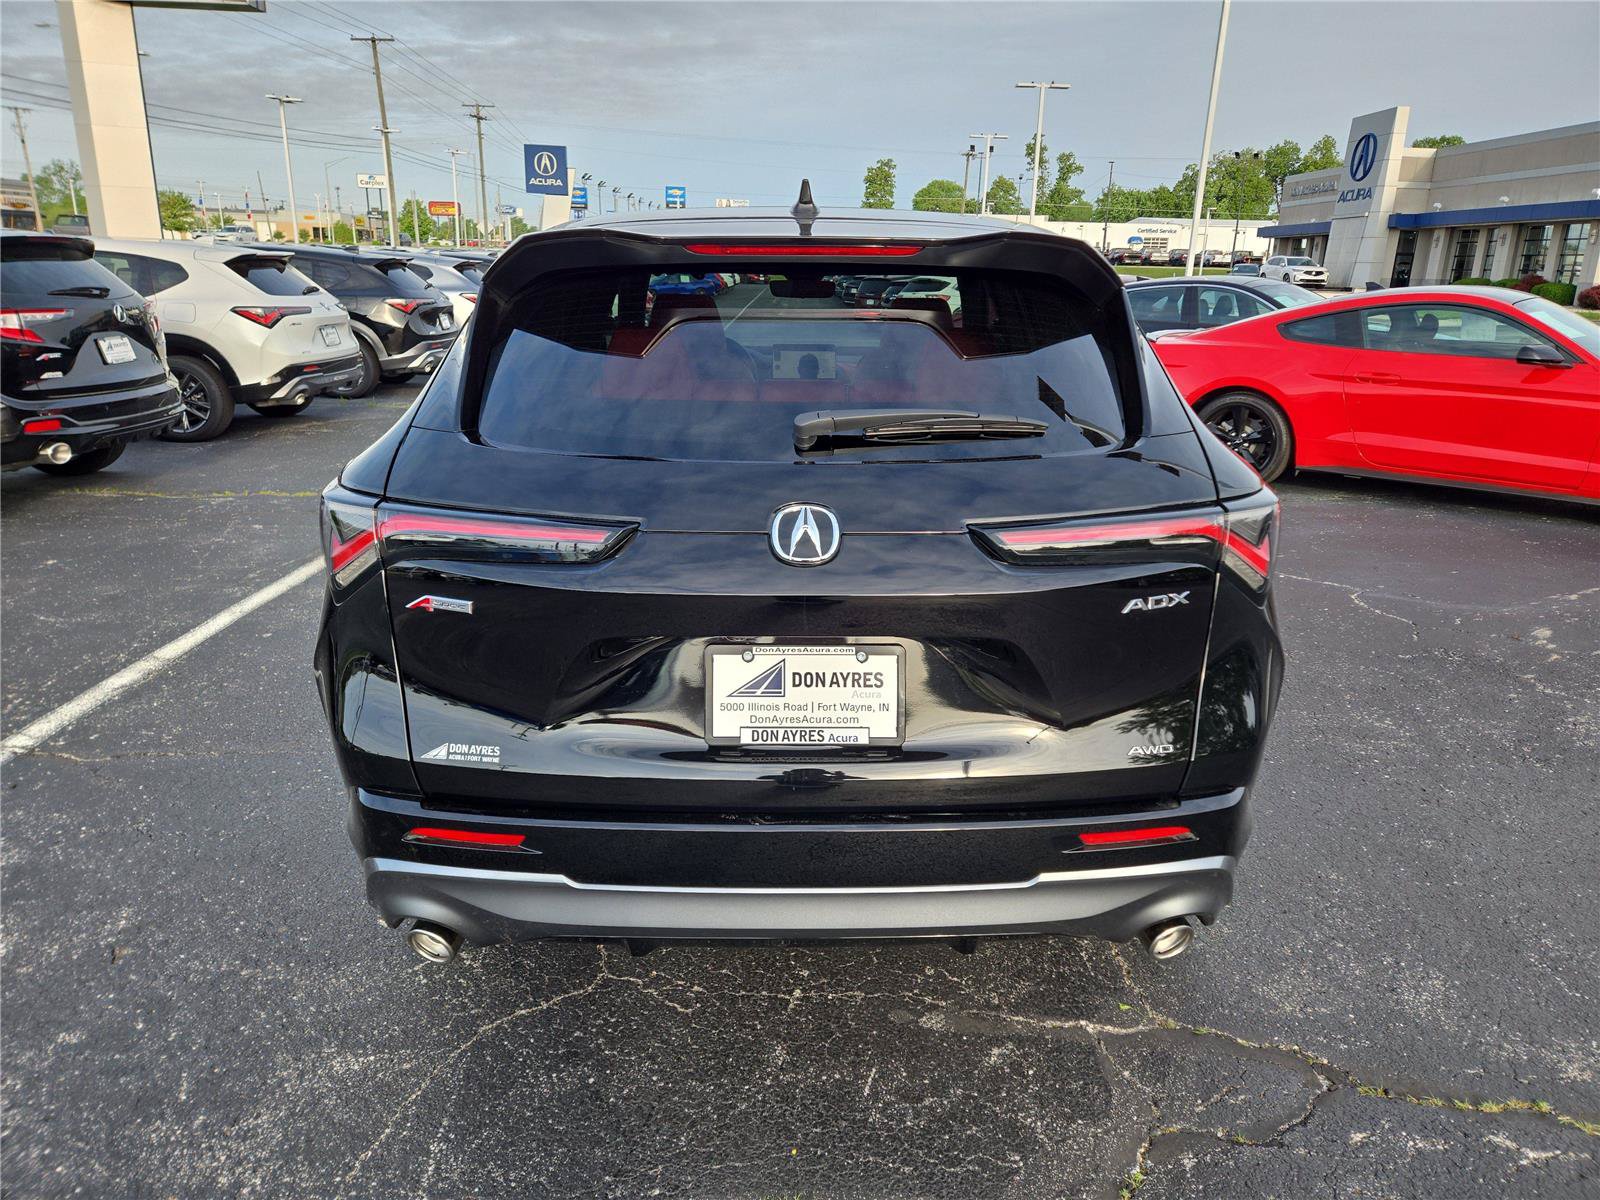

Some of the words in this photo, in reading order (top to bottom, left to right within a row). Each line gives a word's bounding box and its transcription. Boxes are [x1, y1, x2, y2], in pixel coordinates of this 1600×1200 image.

[529, 178, 563, 187] ACURA
[1337, 187, 1372, 203] ACURA
[1121, 591, 1190, 614] ADX
[754, 647, 854, 655] DonAyresAcura.com
[792, 672, 827, 688] DON
[830, 672, 884, 688] AYRES
[851, 690, 882, 699] Acura
[719, 702, 745, 712] 5000
[748, 702, 780, 712] Illinois
[783, 702, 808, 712] Road
[817, 702, 837, 712] Fort
[839, 702, 876, 714] Wayne,
[878, 703, 890, 712] IN
[749, 715, 859, 726] DonAyresAcura.com
[752, 730, 779, 742] DON
[782, 730, 825, 742] AYRES
[828, 731, 859, 743] Acura
[449, 743, 469, 754] DON
[469, 744, 500, 756] AYRES
[1127, 744, 1174, 756] AWD
